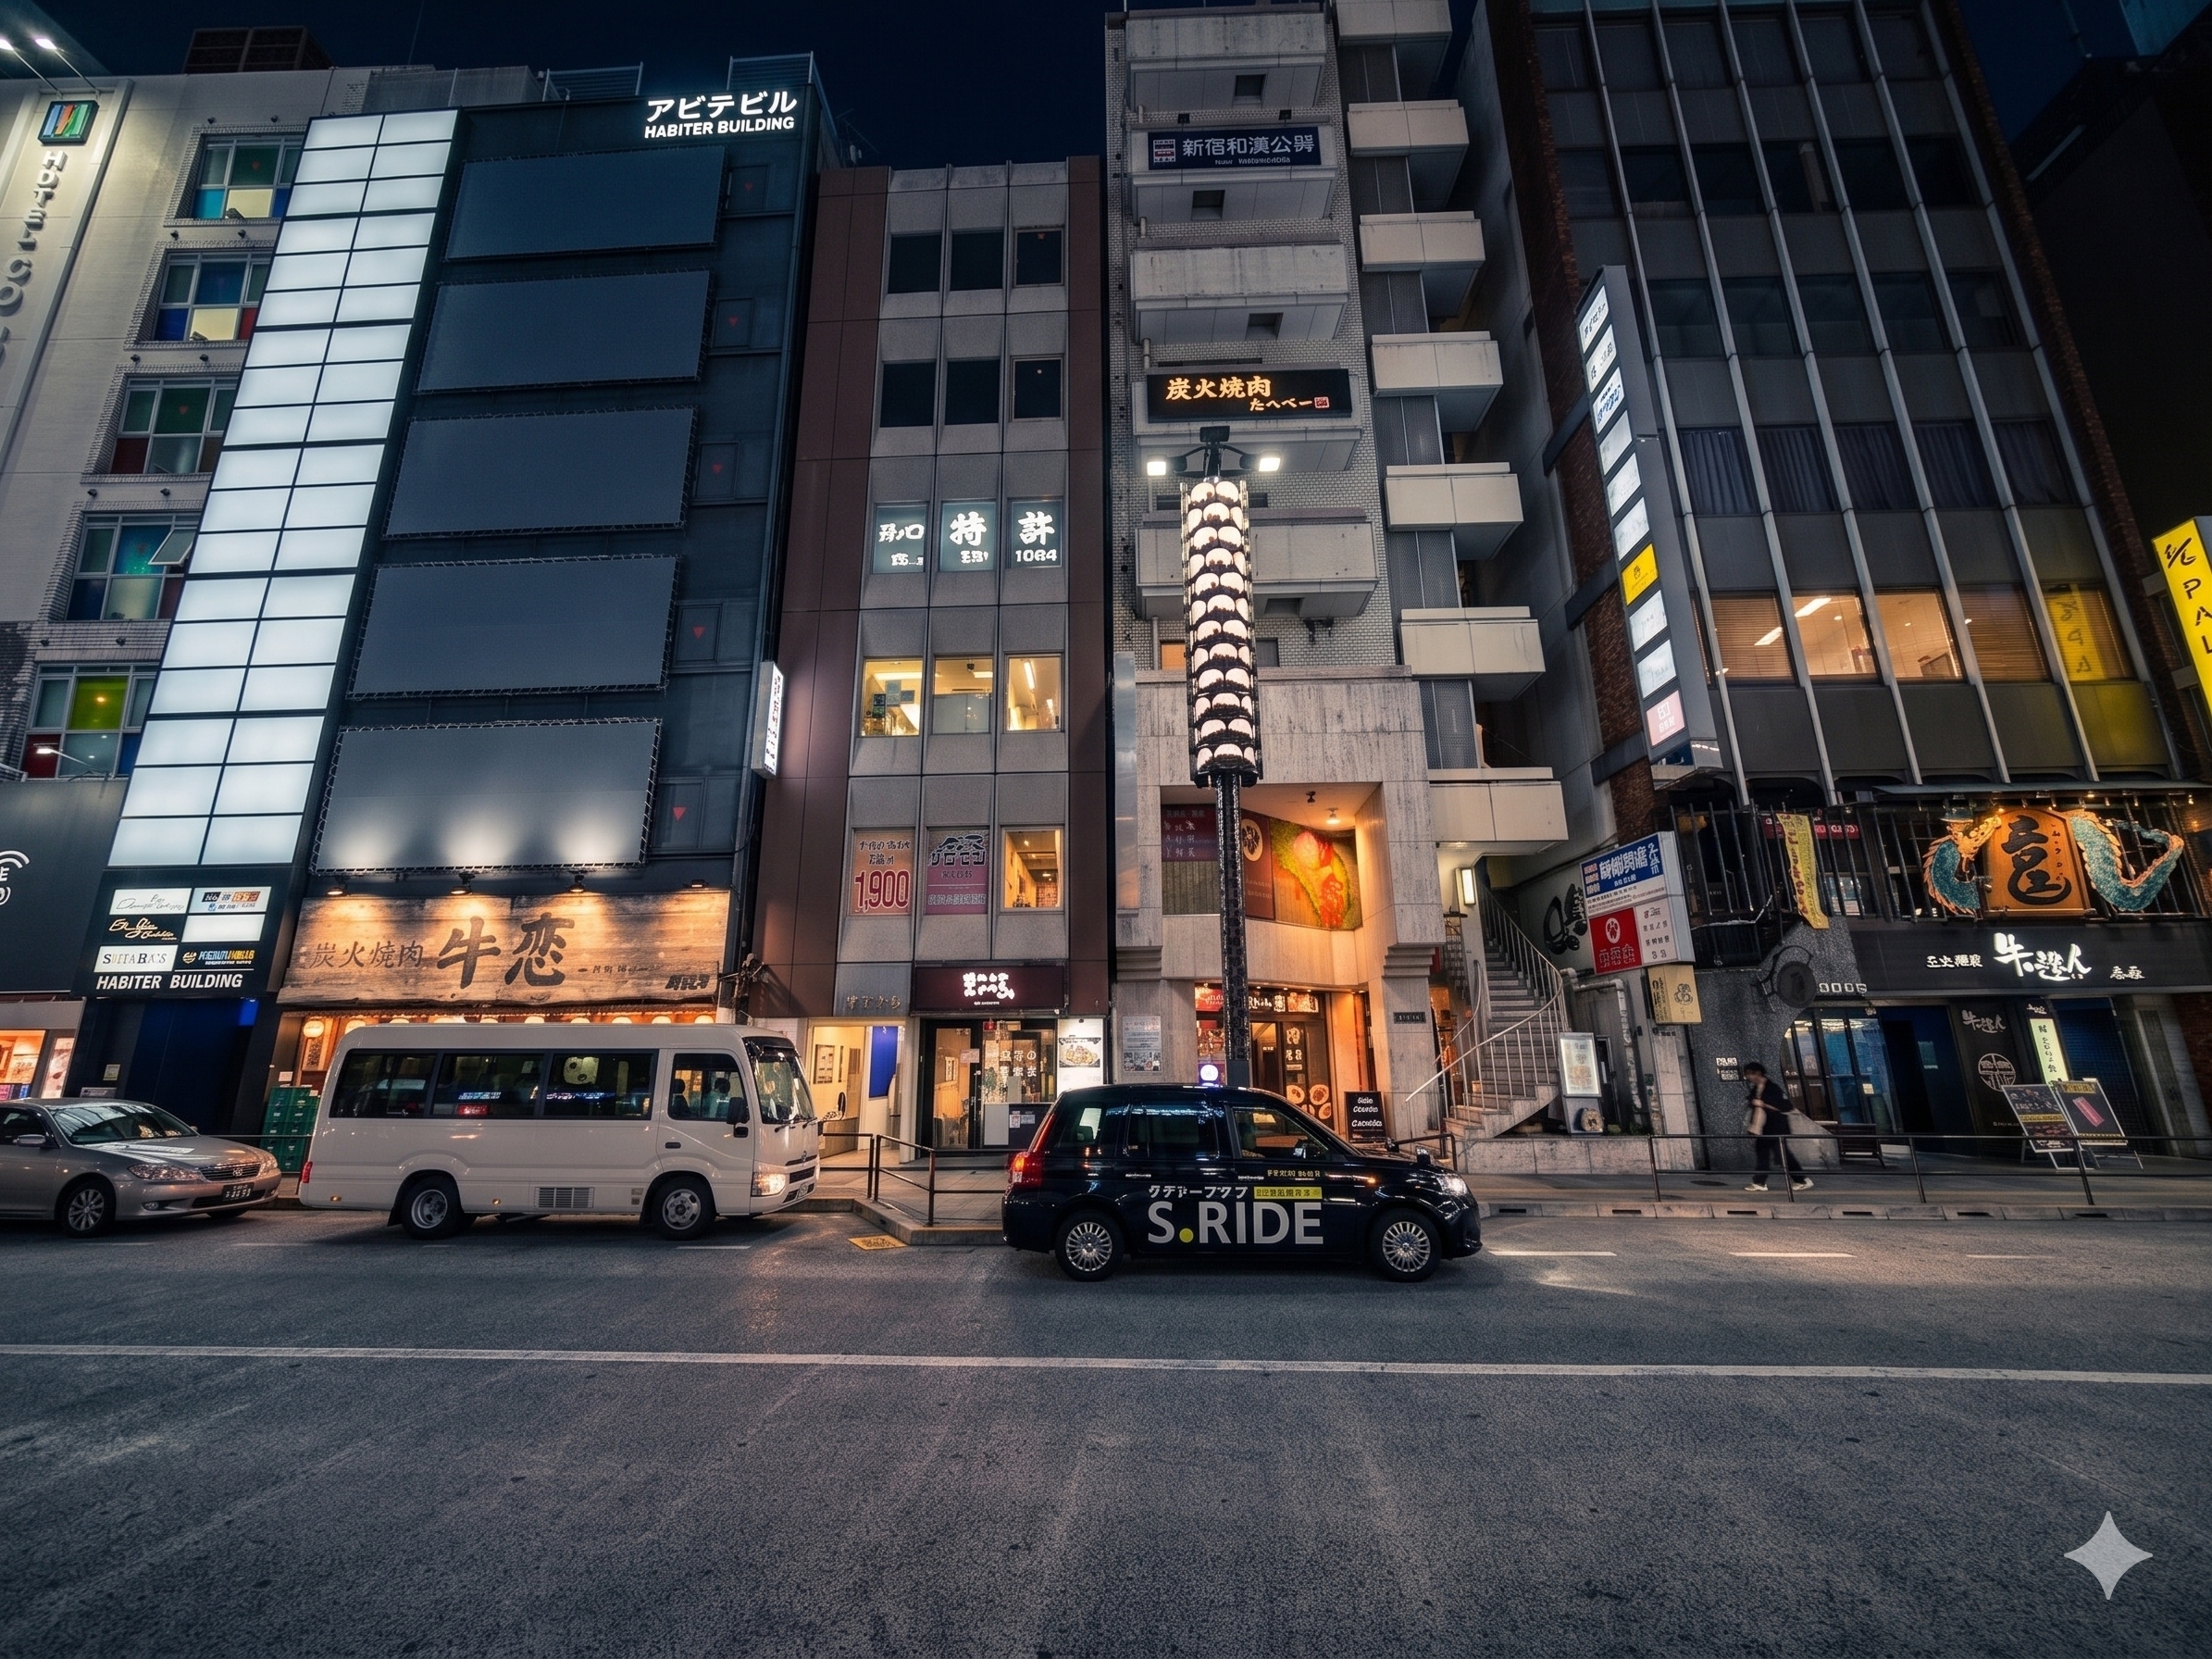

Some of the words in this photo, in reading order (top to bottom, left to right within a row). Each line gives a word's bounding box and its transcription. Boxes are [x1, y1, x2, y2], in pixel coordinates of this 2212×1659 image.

[647, 91, 797, 122] アビテビル
[644, 121, 714, 139] HABITER
[717, 117, 795, 134] BUILDING
[1166, 375, 1272, 400] 炭火焼肉
[854, 869, 911, 911] 1,900
[309, 939, 423, 969] 炭火焼肉
[436, 912, 576, 990] 牛恋
[96, 976, 163, 990] HABITER
[169, 974, 243, 989] BUILDING
[1148, 1201, 1323, 1245] S.RIDE
